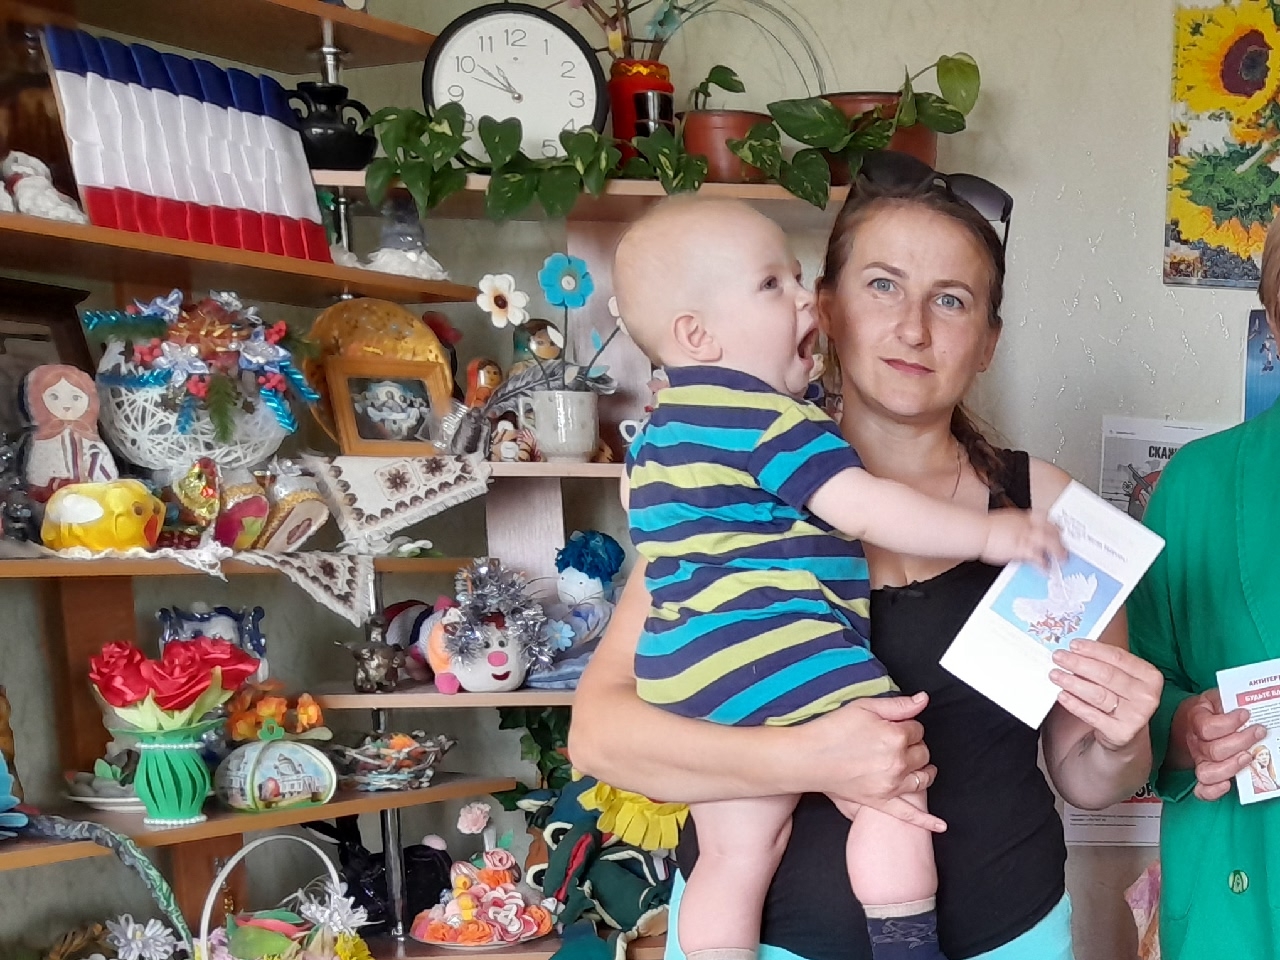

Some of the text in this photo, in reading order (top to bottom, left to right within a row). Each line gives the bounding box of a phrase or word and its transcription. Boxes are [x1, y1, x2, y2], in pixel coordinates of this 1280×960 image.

[479, 35, 494, 53] 11
[504, 29, 527, 47] 12
[543, 38, 549, 55] 1
[455, 55, 476, 74] 10
[560, 60, 576, 79] 2
[447, 84, 465, 103] 9
[568, 90, 585, 108] 3
[541, 139, 558, 158] 5
[1148, 445, 1180, 460] СКАЖ
[1244, 691, 1271, 702] БУДЬТЕ
